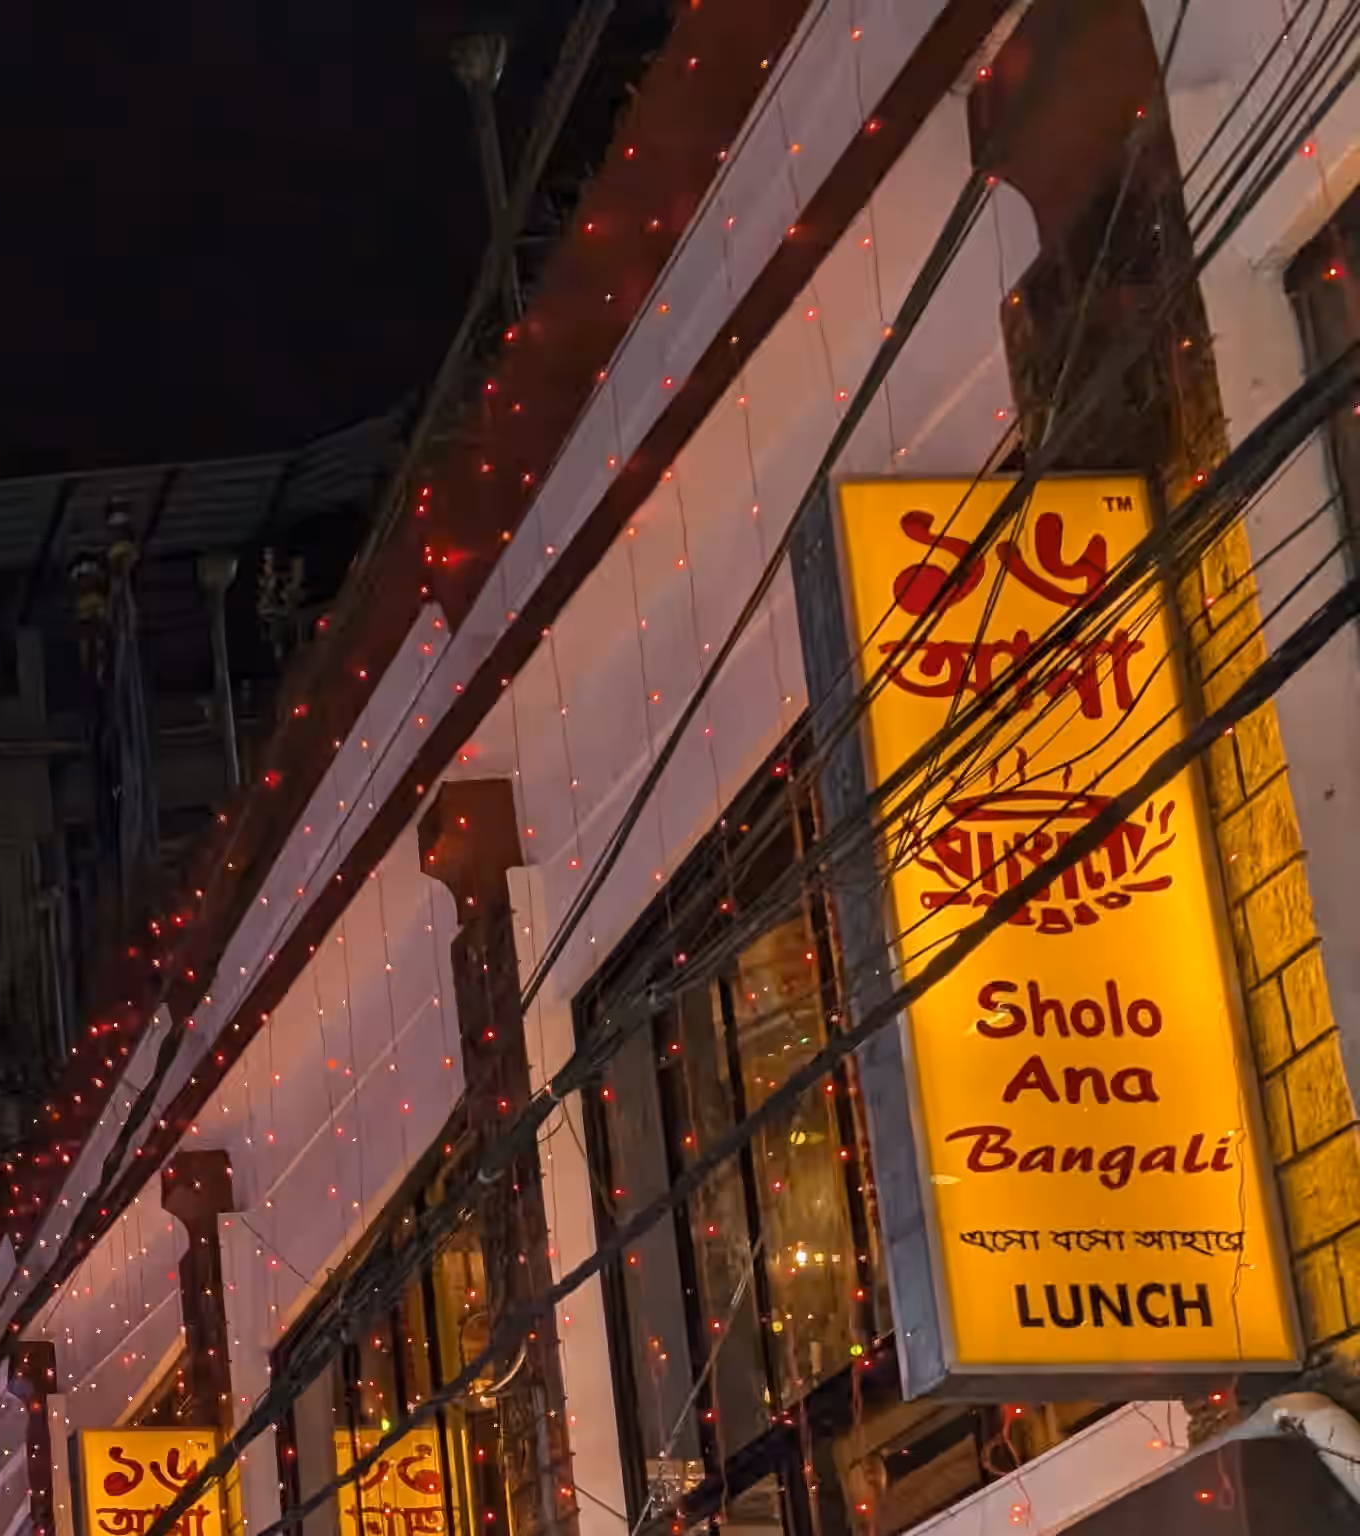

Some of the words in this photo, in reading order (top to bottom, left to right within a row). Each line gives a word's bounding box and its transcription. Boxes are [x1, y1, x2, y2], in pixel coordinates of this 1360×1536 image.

[1102, 496, 1132, 512] TM
[976, 979, 1162, 1038] Sholo
[1002, 1055, 1160, 1104] Ana
[945, 1126, 1233, 1190] Bangali
[1015, 1283, 1212, 1328] LUNCH
